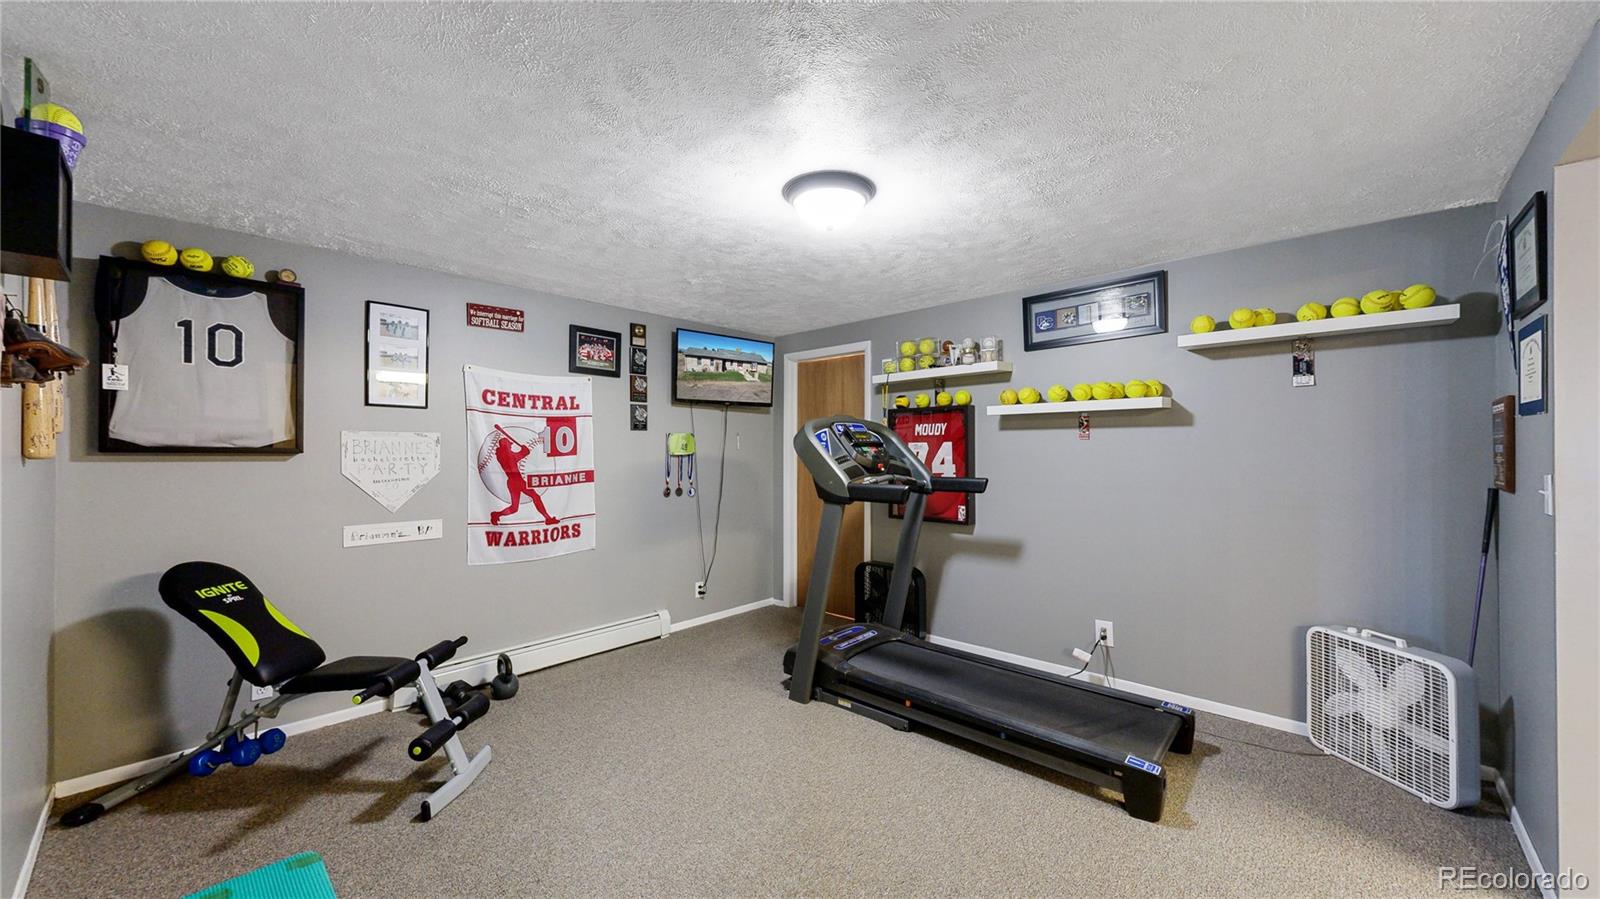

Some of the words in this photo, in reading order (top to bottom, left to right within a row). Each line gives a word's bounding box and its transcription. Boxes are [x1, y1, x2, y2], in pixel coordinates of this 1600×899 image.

[470, 317, 499, 327] SOFTBALL
[501, 321, 522, 330] SEASON
[175, 318, 245, 368] 10
[481, 388, 580, 411] CENTRAL
[914, 422, 948, 436] MOUDY
[538, 426, 575, 454] 10
[531, 472, 587, 487] BRIANNE
[485, 522, 581, 547] WARRIORS
[195, 581, 248, 598] IGNITE
